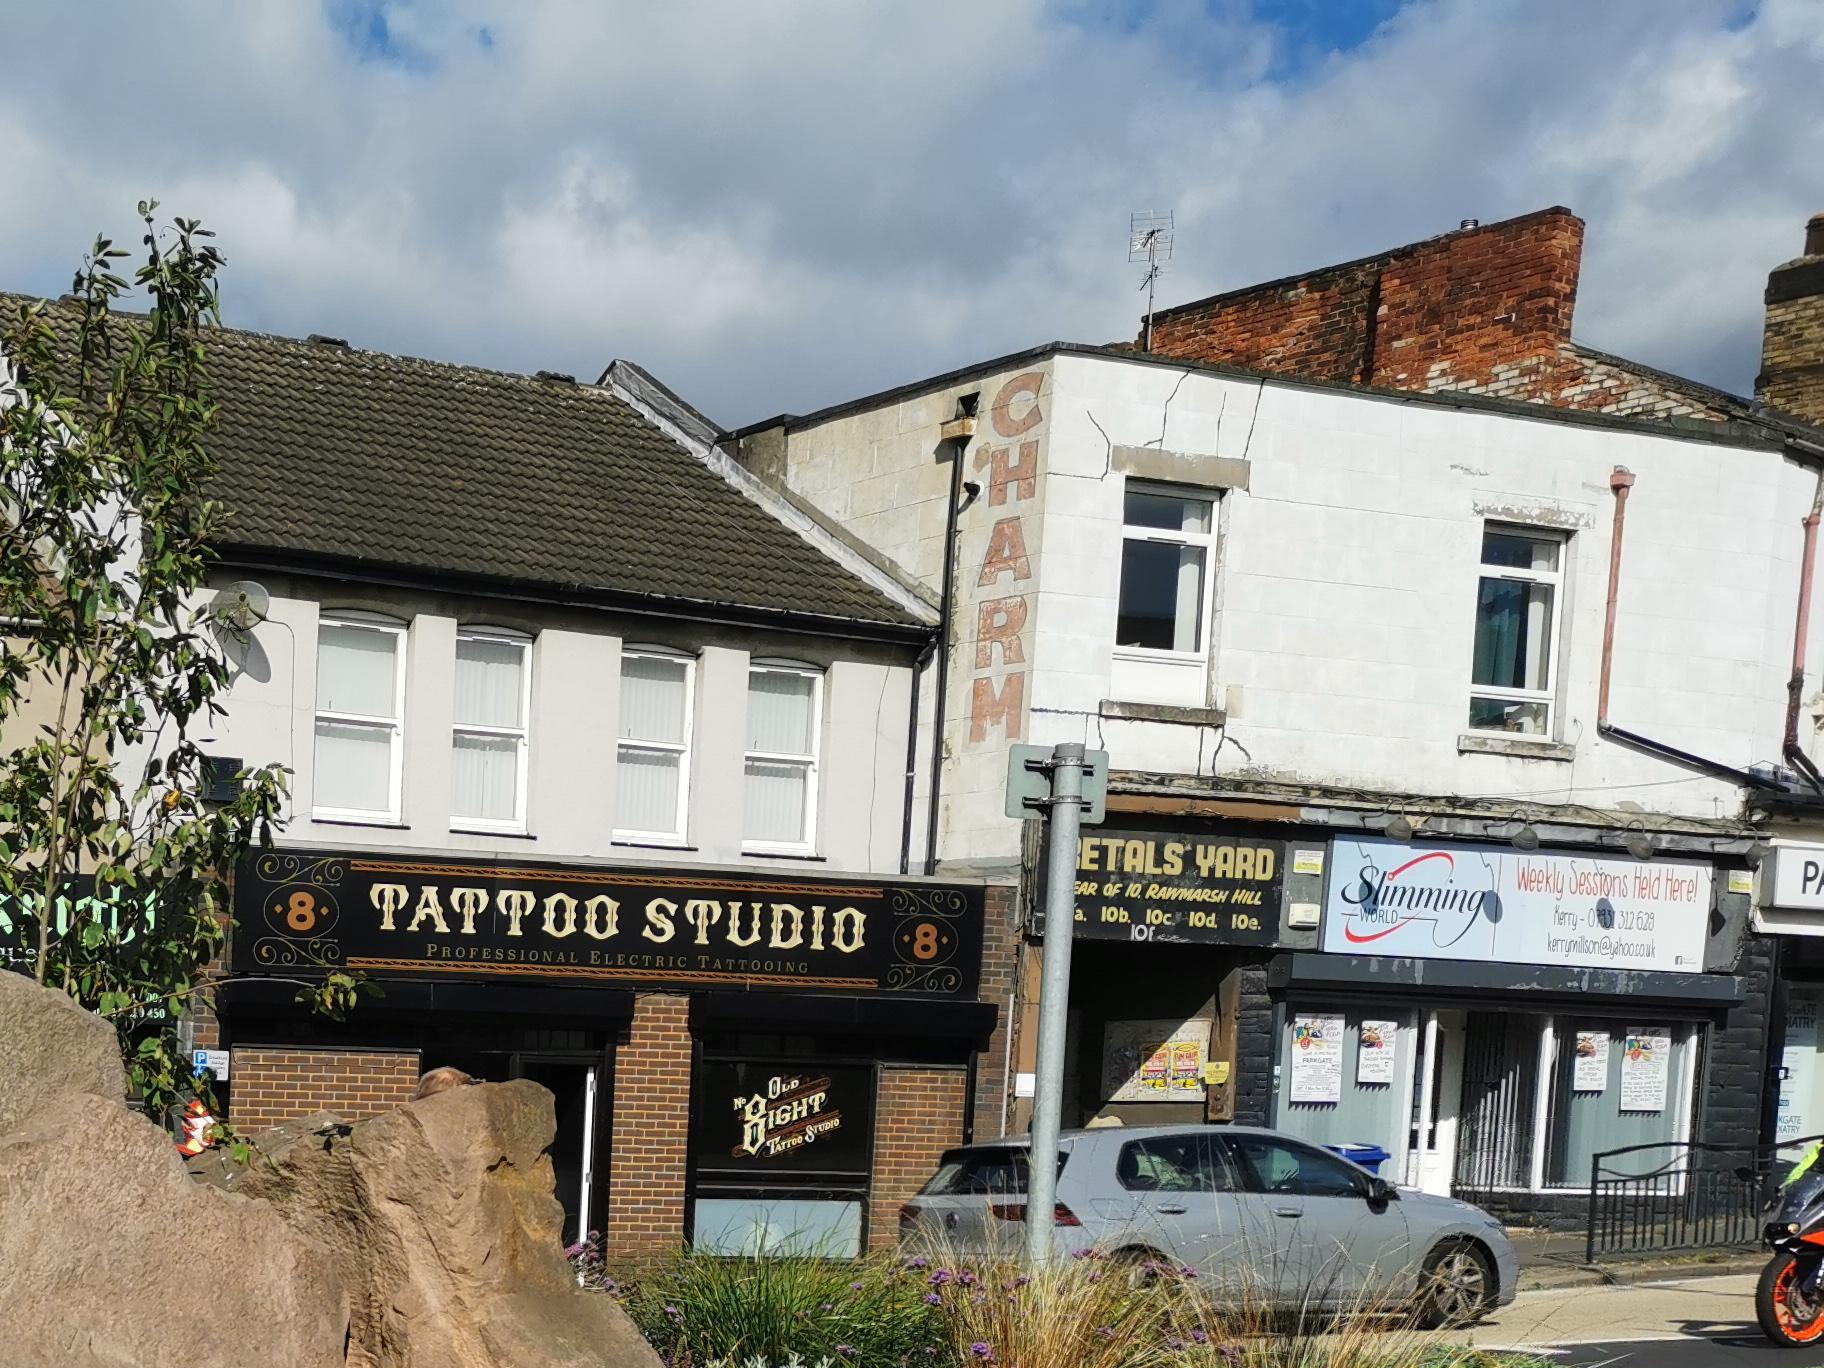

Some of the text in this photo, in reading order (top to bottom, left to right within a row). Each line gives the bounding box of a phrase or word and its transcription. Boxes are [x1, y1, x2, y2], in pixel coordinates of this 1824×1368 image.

[970, 371, 1046, 744] CHARM
[1075, 837, 1184, 876] ETALS
[1195, 844, 1276, 881] YARD
[1073, 880, 1098, 896] EAR
[1102, 883, 1123, 898] OF
[1145, 884, 1228, 905] RAWMARSH
[1230, 886, 1263, 906] HILL
[1341, 865, 1488, 935] Slimming
[1517, 858, 1700, 904] Weekly Sessions Held Here!
[287, 891, 316, 931] 8
[369, 882, 868, 954] TATTOO STUDIO
[1360, 907, 1399, 925] WORLD
[1553, 904, 1578, 931] Kerry
[1617, 910, 1635, 930] 312
[426, 943, 810, 974] PROFESSIONAL ELECTRIC TATTOOING
[913, 922, 938, 960] 8
[767, 1076, 800, 1100] OLD
